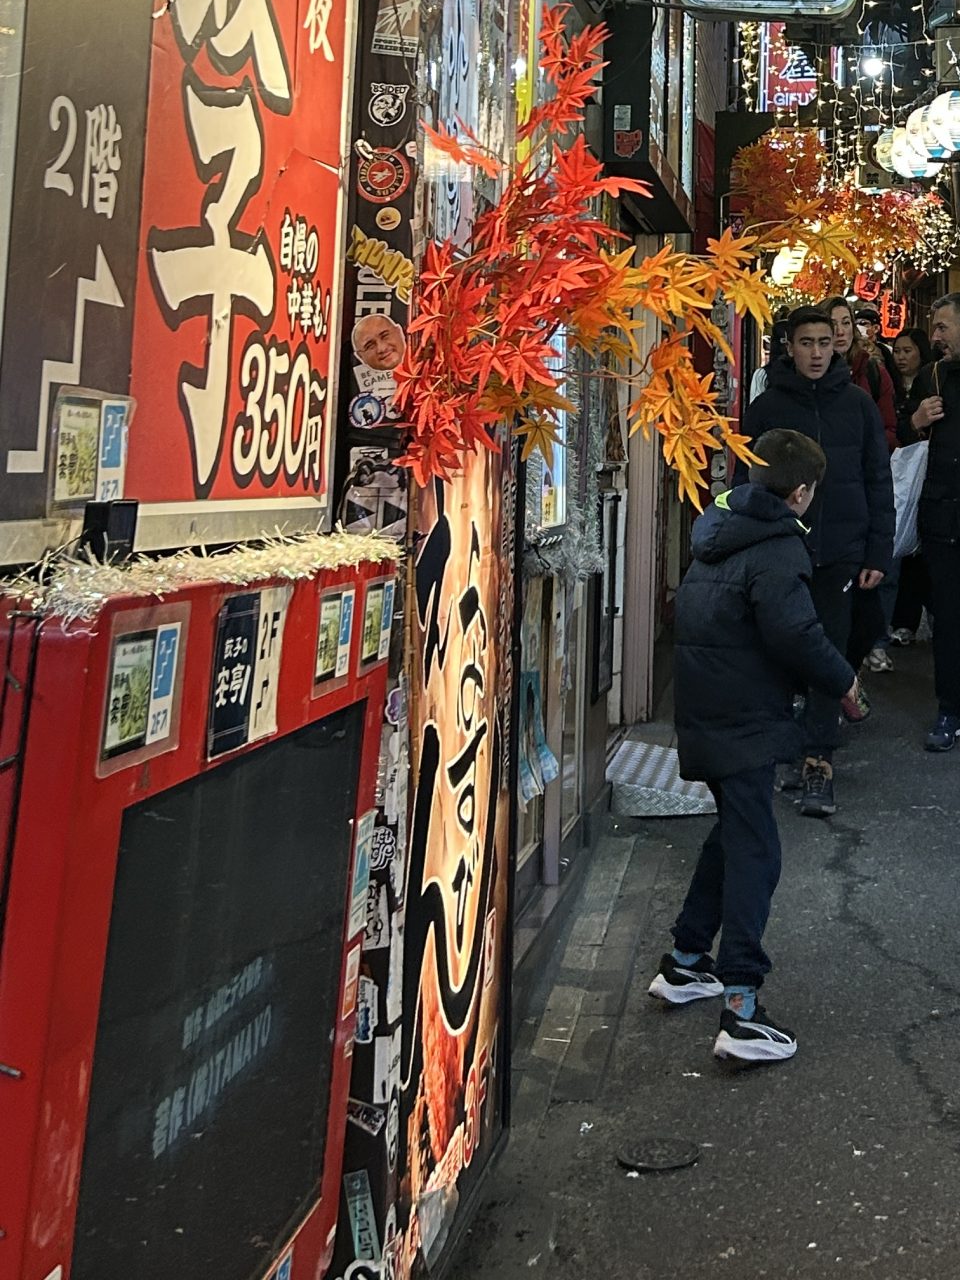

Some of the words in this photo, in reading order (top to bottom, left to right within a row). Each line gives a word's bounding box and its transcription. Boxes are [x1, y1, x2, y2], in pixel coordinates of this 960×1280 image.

[43, 94, 122, 220] 2階
[280, 214, 319, 275] 自慢の
